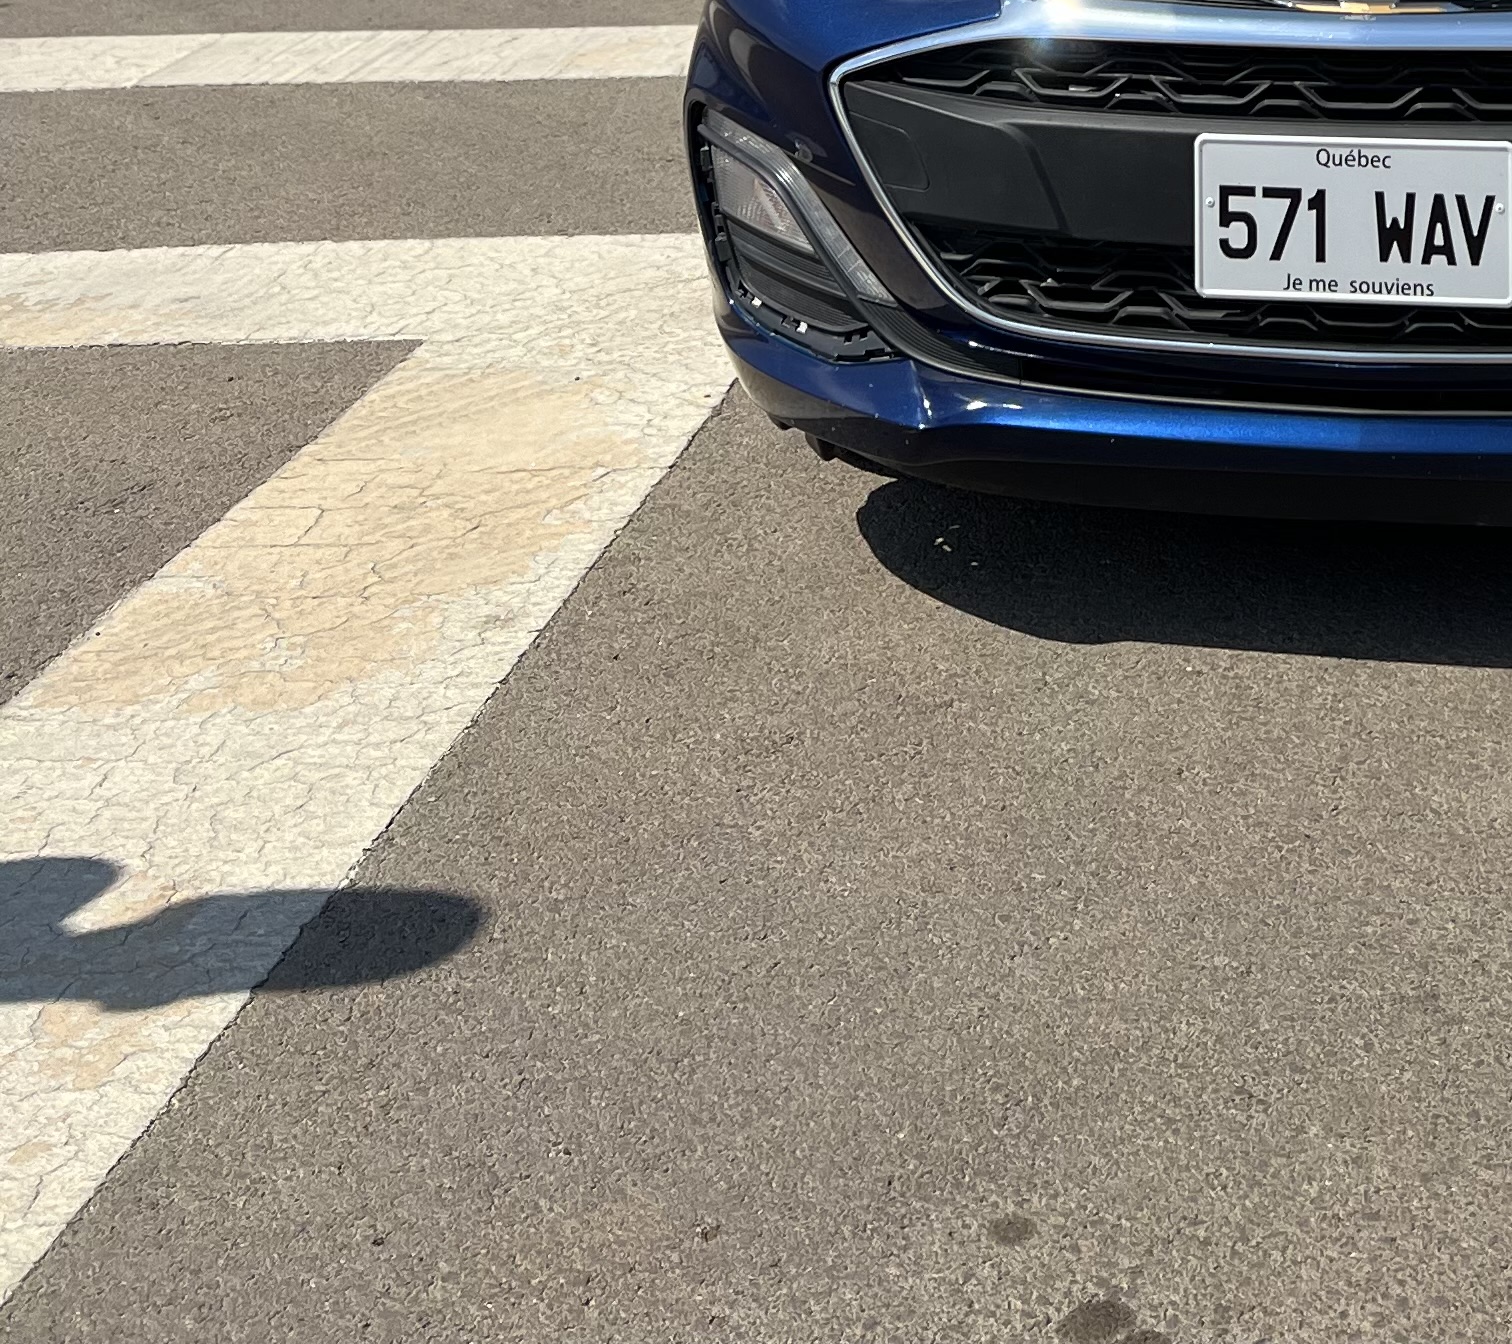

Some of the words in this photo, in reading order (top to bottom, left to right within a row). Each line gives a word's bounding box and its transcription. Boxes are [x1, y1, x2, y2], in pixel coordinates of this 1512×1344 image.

[1315, 148, 1392, 169] Québec
[1218, 184, 1327, 264] 571
[1374, 190, 1497, 267] WAV
[1283, 273, 1303, 291] Je
[1308, 278, 1339, 293] me
[1349, 278, 1435, 297] souviens
